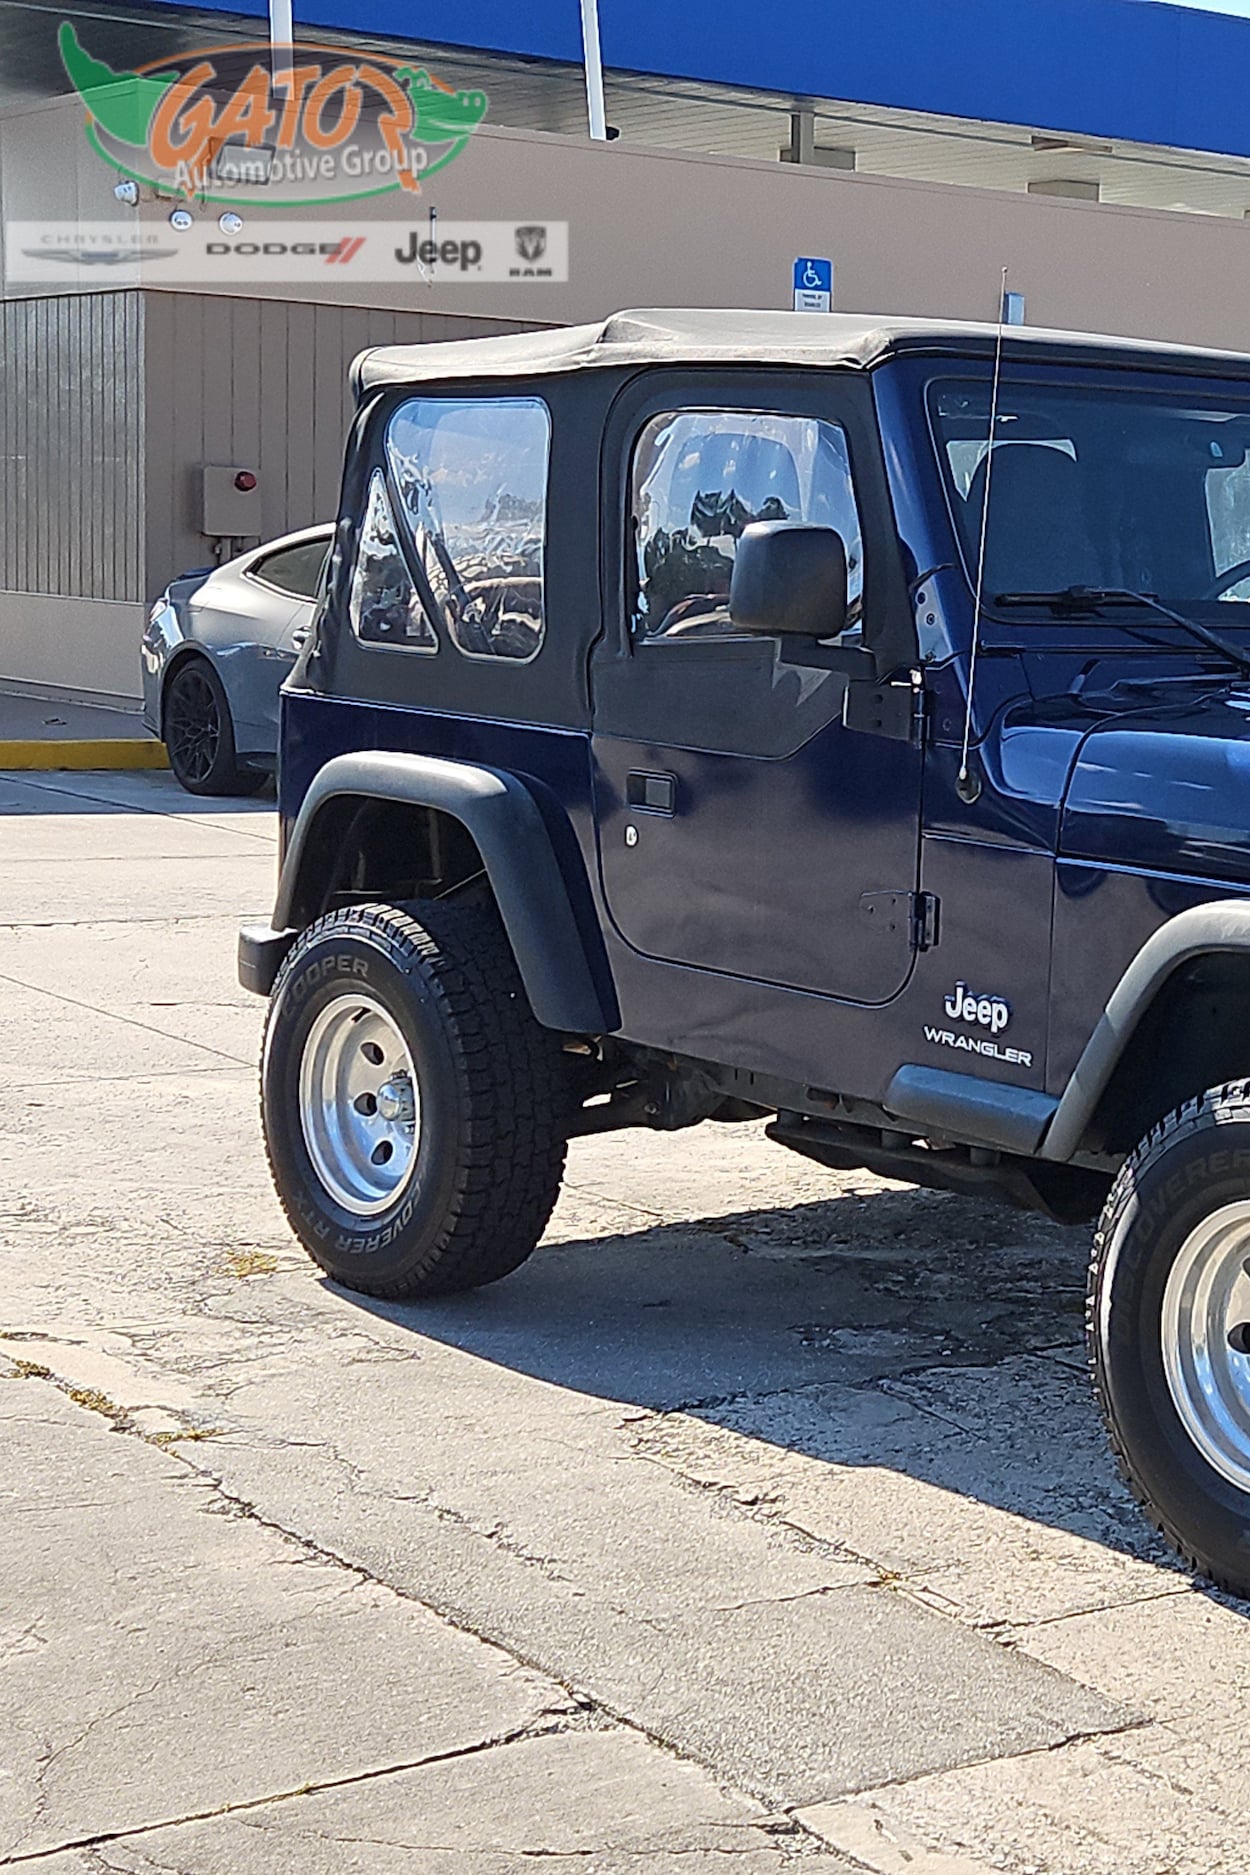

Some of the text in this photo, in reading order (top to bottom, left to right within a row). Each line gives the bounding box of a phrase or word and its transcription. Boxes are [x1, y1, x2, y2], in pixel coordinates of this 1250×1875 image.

[281, 954, 369, 1015] COOPER
[945, 981, 1009, 1033] Jeep
[923, 1025, 1032, 1067] WRANGLER
